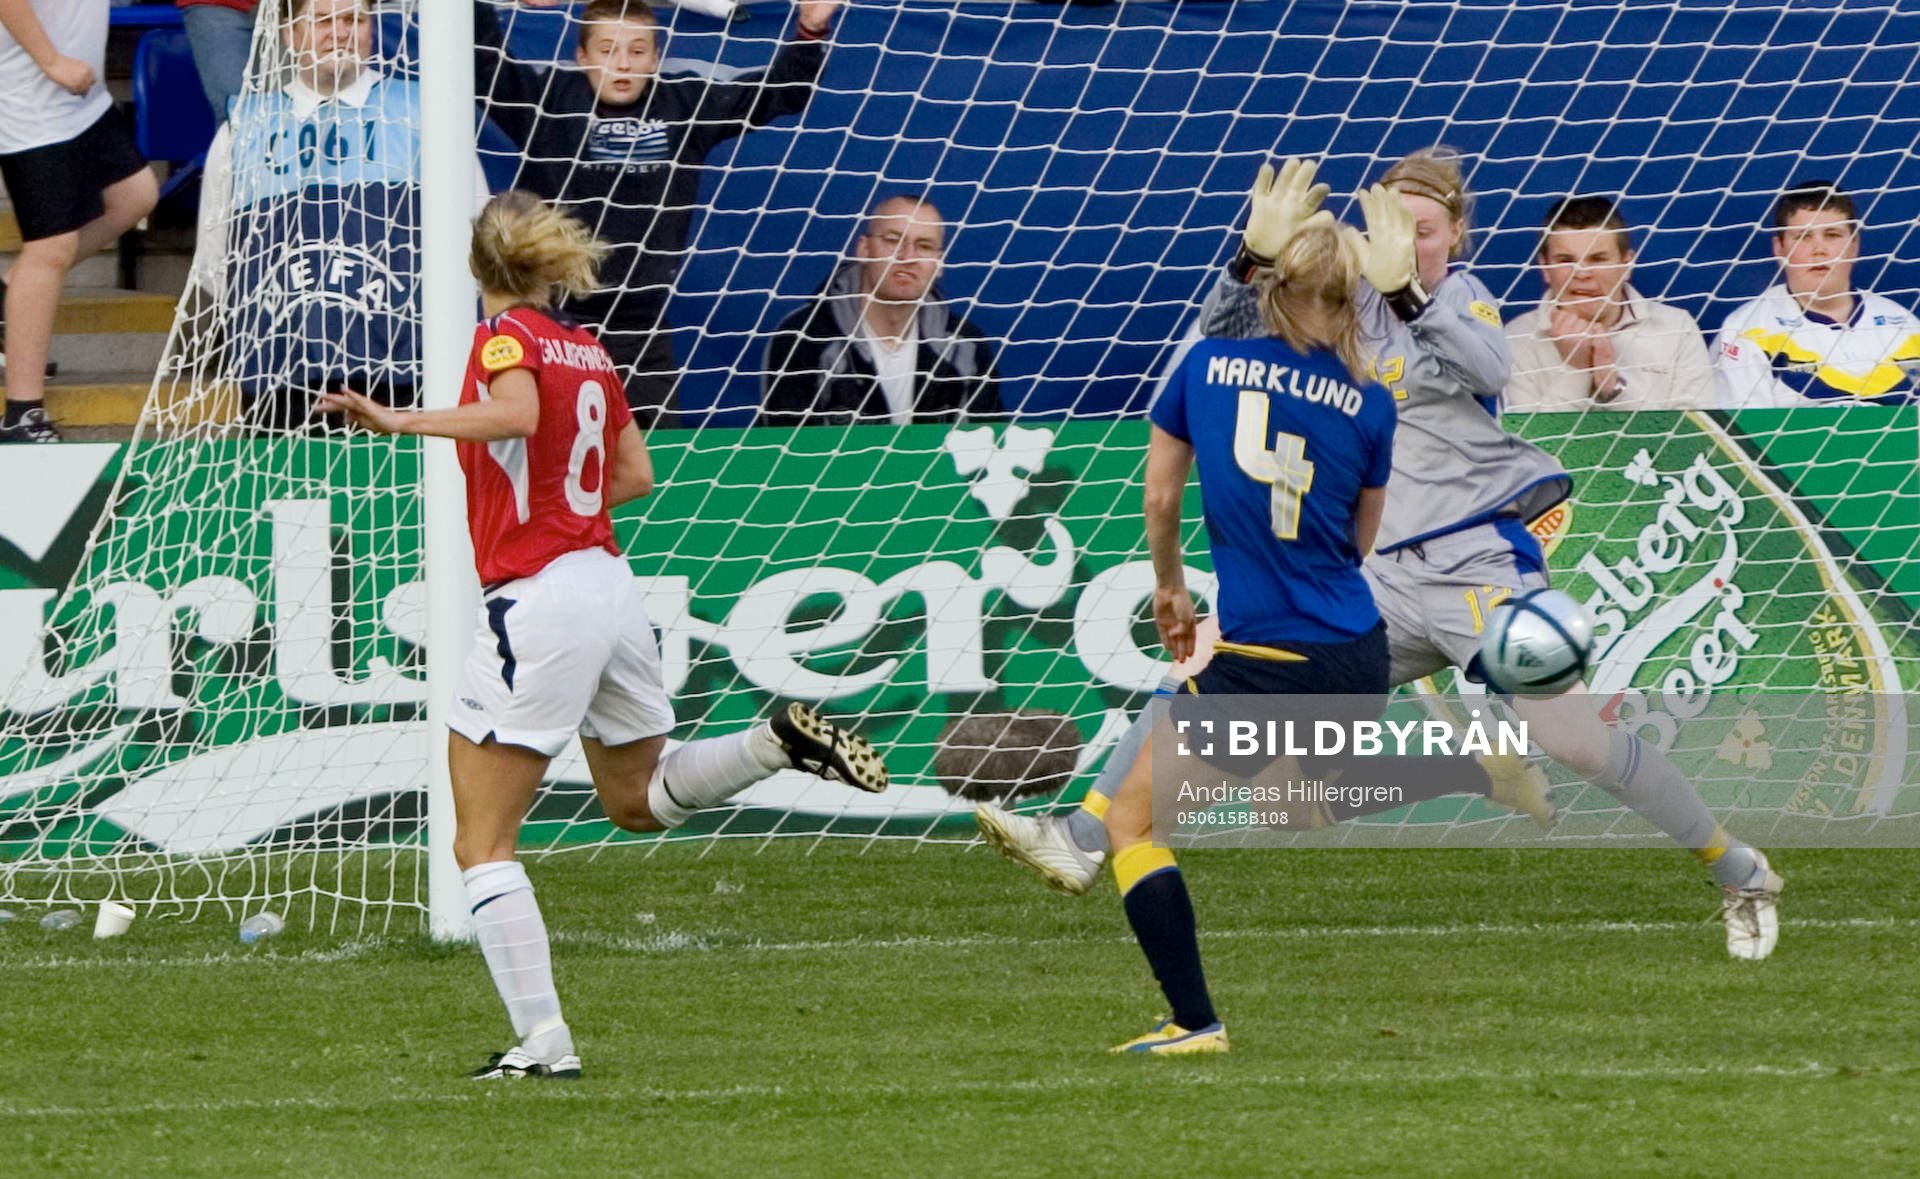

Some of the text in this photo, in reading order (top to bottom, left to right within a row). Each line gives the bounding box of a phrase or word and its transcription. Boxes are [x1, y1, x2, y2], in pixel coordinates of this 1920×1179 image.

[564, 380, 606, 516] 8
[1206, 356, 1364, 417] MARKLUND
[1234, 390, 1315, 540] 4
[1814, 603, 1868, 778] DENMARK
